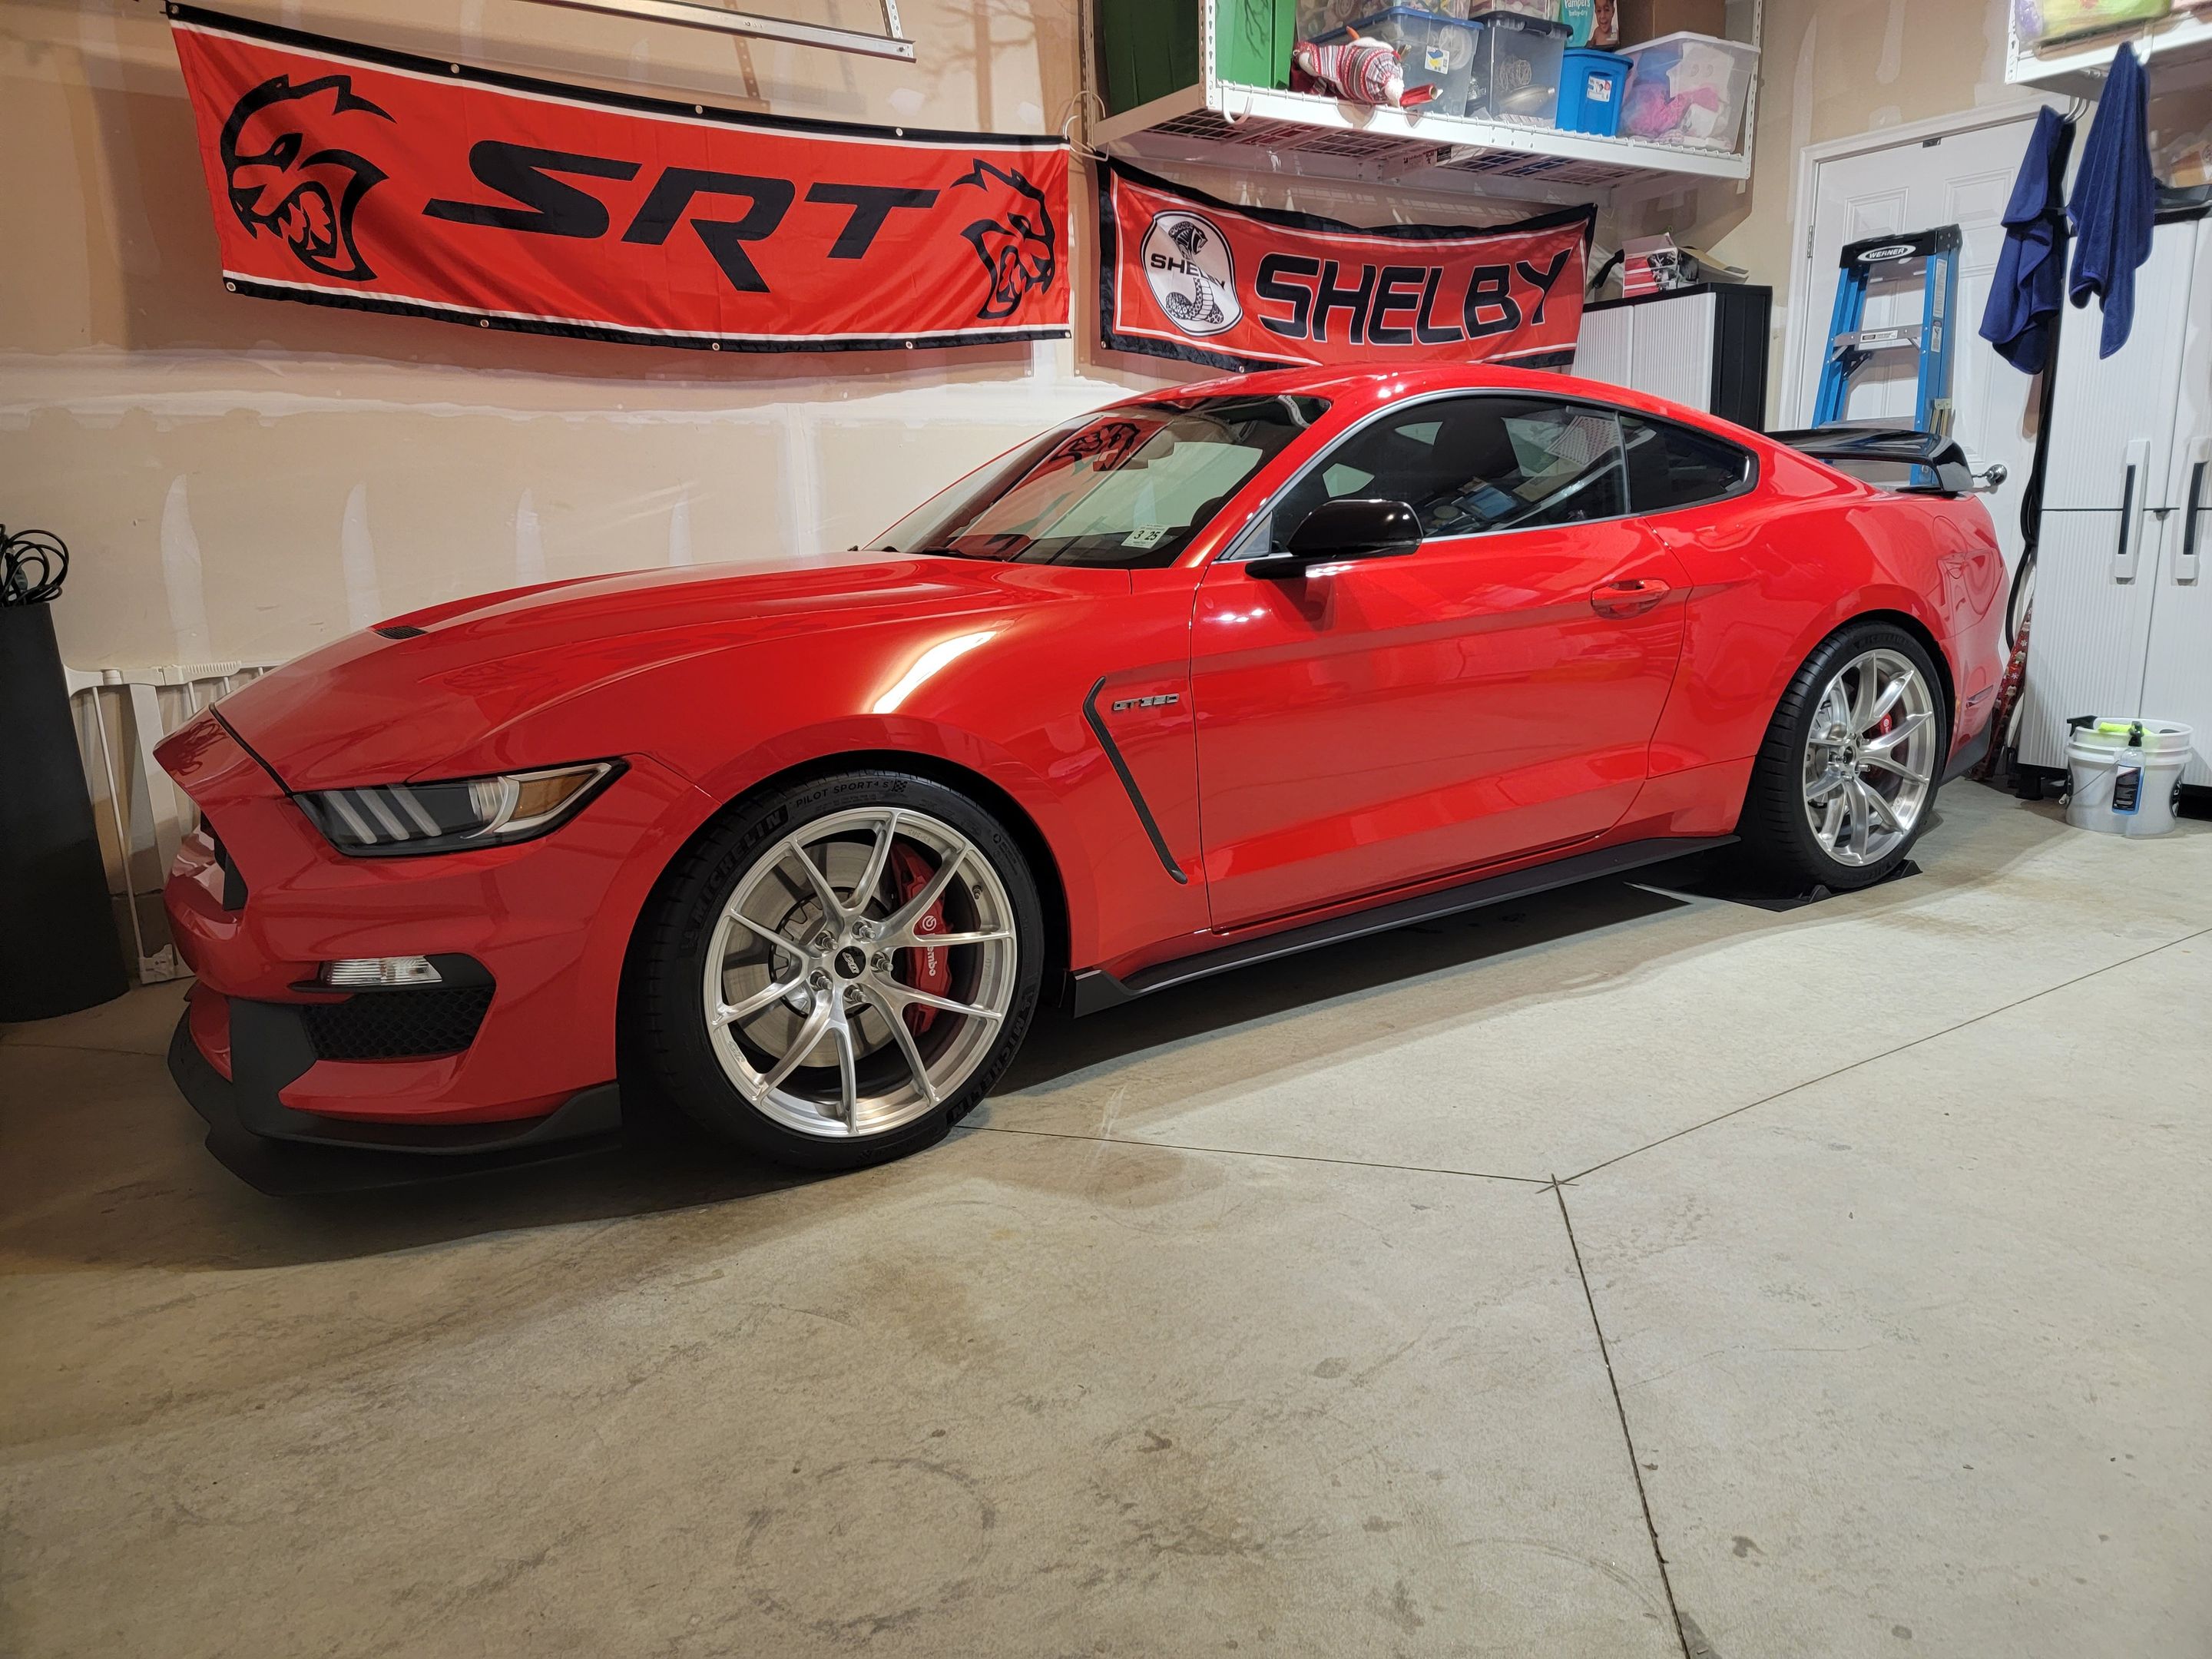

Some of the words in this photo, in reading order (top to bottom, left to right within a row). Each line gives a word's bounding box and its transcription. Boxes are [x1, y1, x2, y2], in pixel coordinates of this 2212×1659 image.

[422, 140, 940, 292] SRT
[1868, 247, 1906, 259] WERNER
[1256, 248, 1572, 345] SHELBY
[1133, 530, 1145, 539] 3
[1144, 531, 1161, 541] 25
[796, 788, 829, 807] PILOT
[695, 808, 785, 928] MICHELIN
[927, 943, 937, 977] embo
[952, 1017, 1026, 1120] MICHELIN
